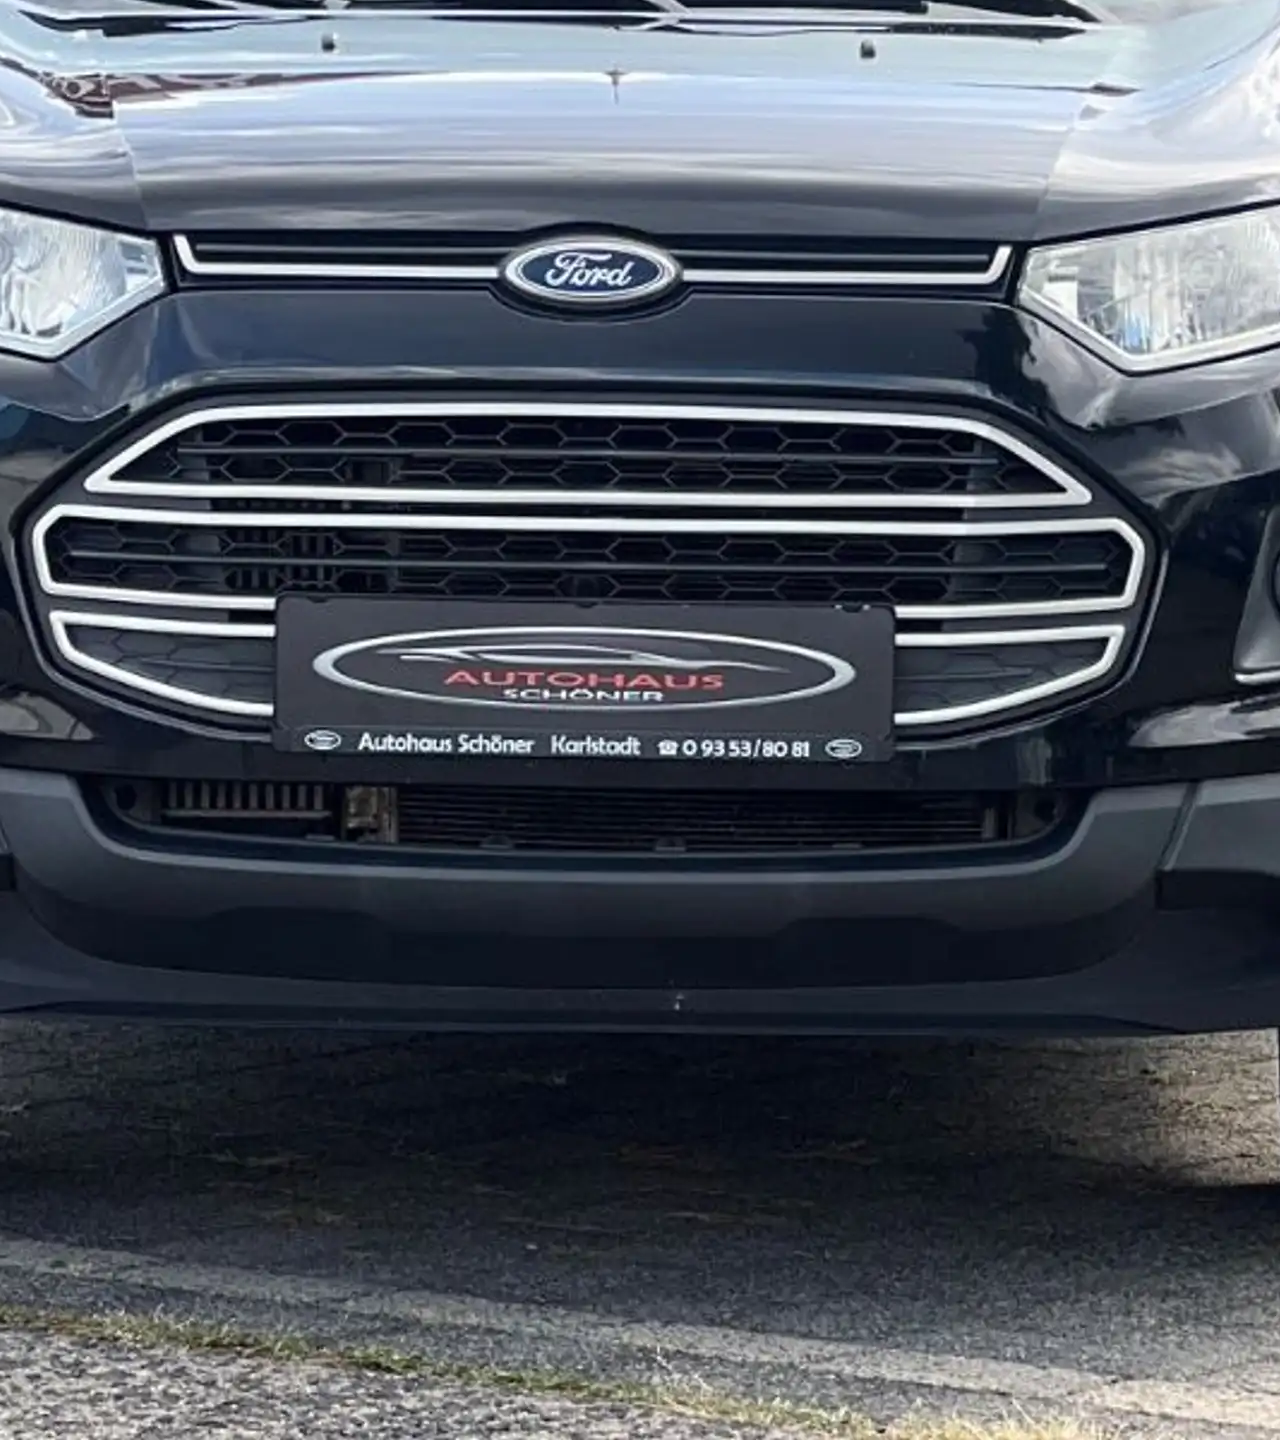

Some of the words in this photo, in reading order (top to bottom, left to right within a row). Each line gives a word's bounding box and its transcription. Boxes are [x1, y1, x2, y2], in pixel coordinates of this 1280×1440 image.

[544, 252, 635, 287] Ford
[444, 670, 724, 690] AUTOHAUS
[502, 687, 664, 702] SCHÖNER
[358, 732, 452, 753] Autohaus
[458, 733, 535, 754] Schöner
[550, 734, 642, 756] Karlstadt
